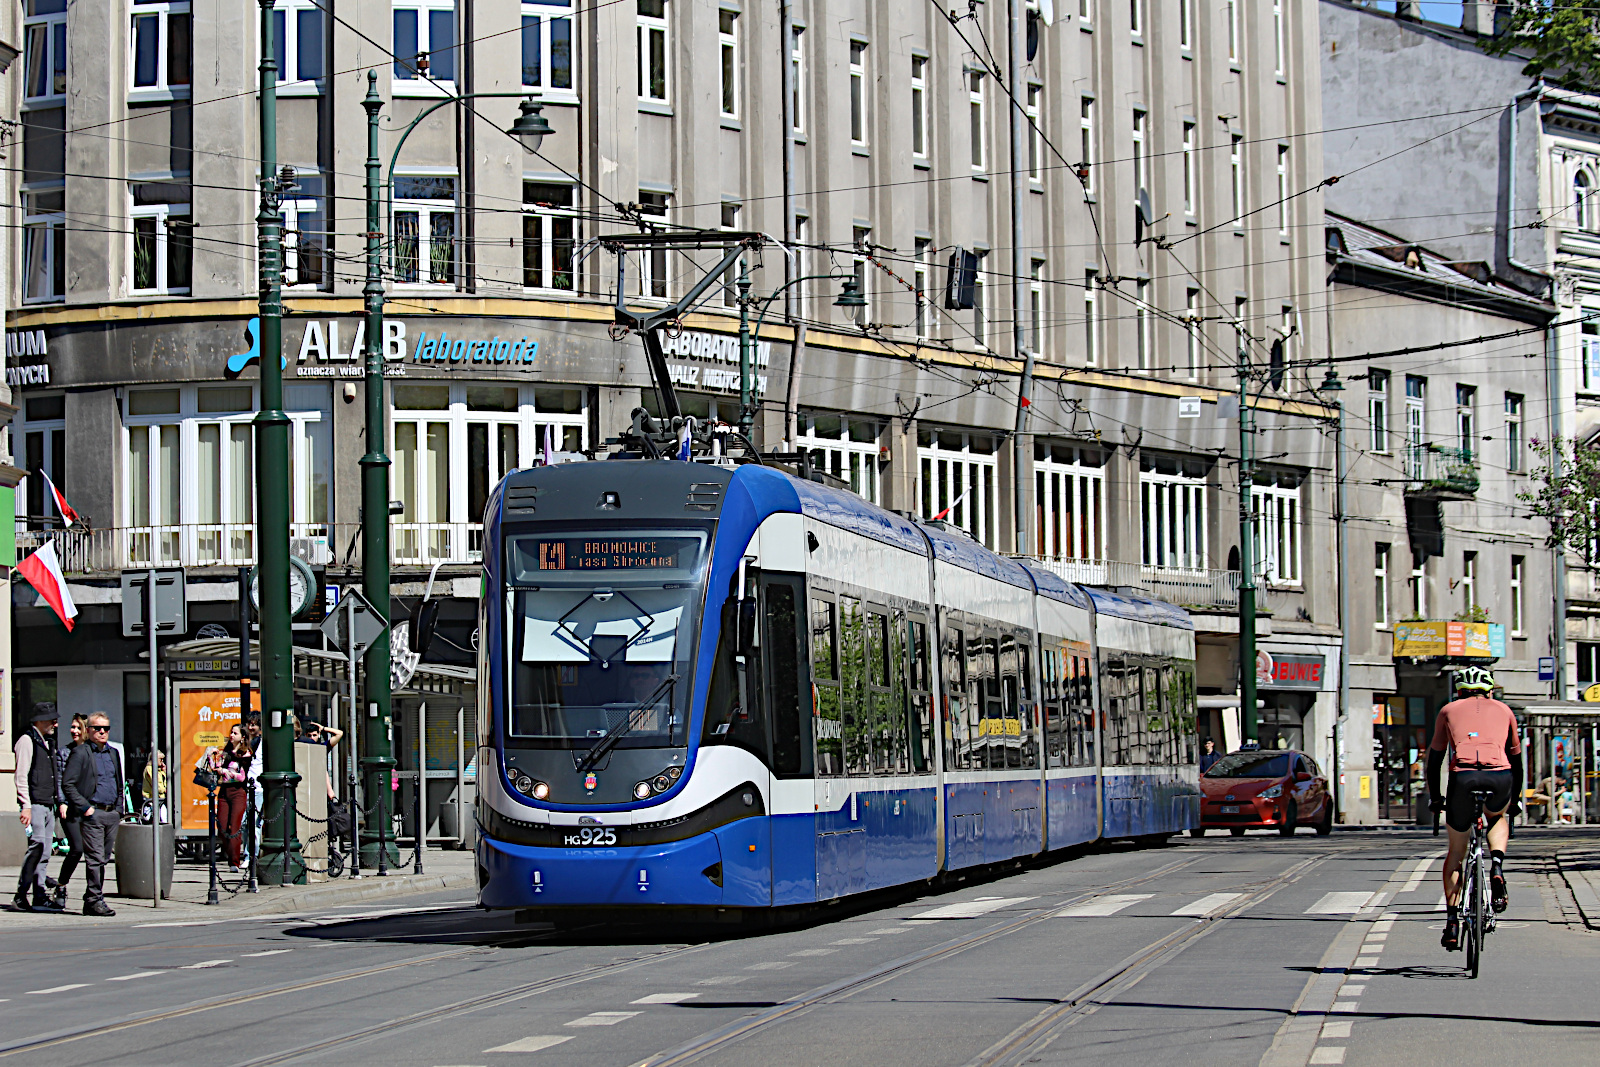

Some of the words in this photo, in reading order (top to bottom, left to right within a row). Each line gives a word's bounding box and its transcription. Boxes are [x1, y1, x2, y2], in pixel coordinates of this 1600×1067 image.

[6, 329, 47, 357] IUM
[414, 331, 539, 362] laboratoria
[297, 365, 335, 376] oznacza
[1272, 661, 1322, 681] OBUWIE
